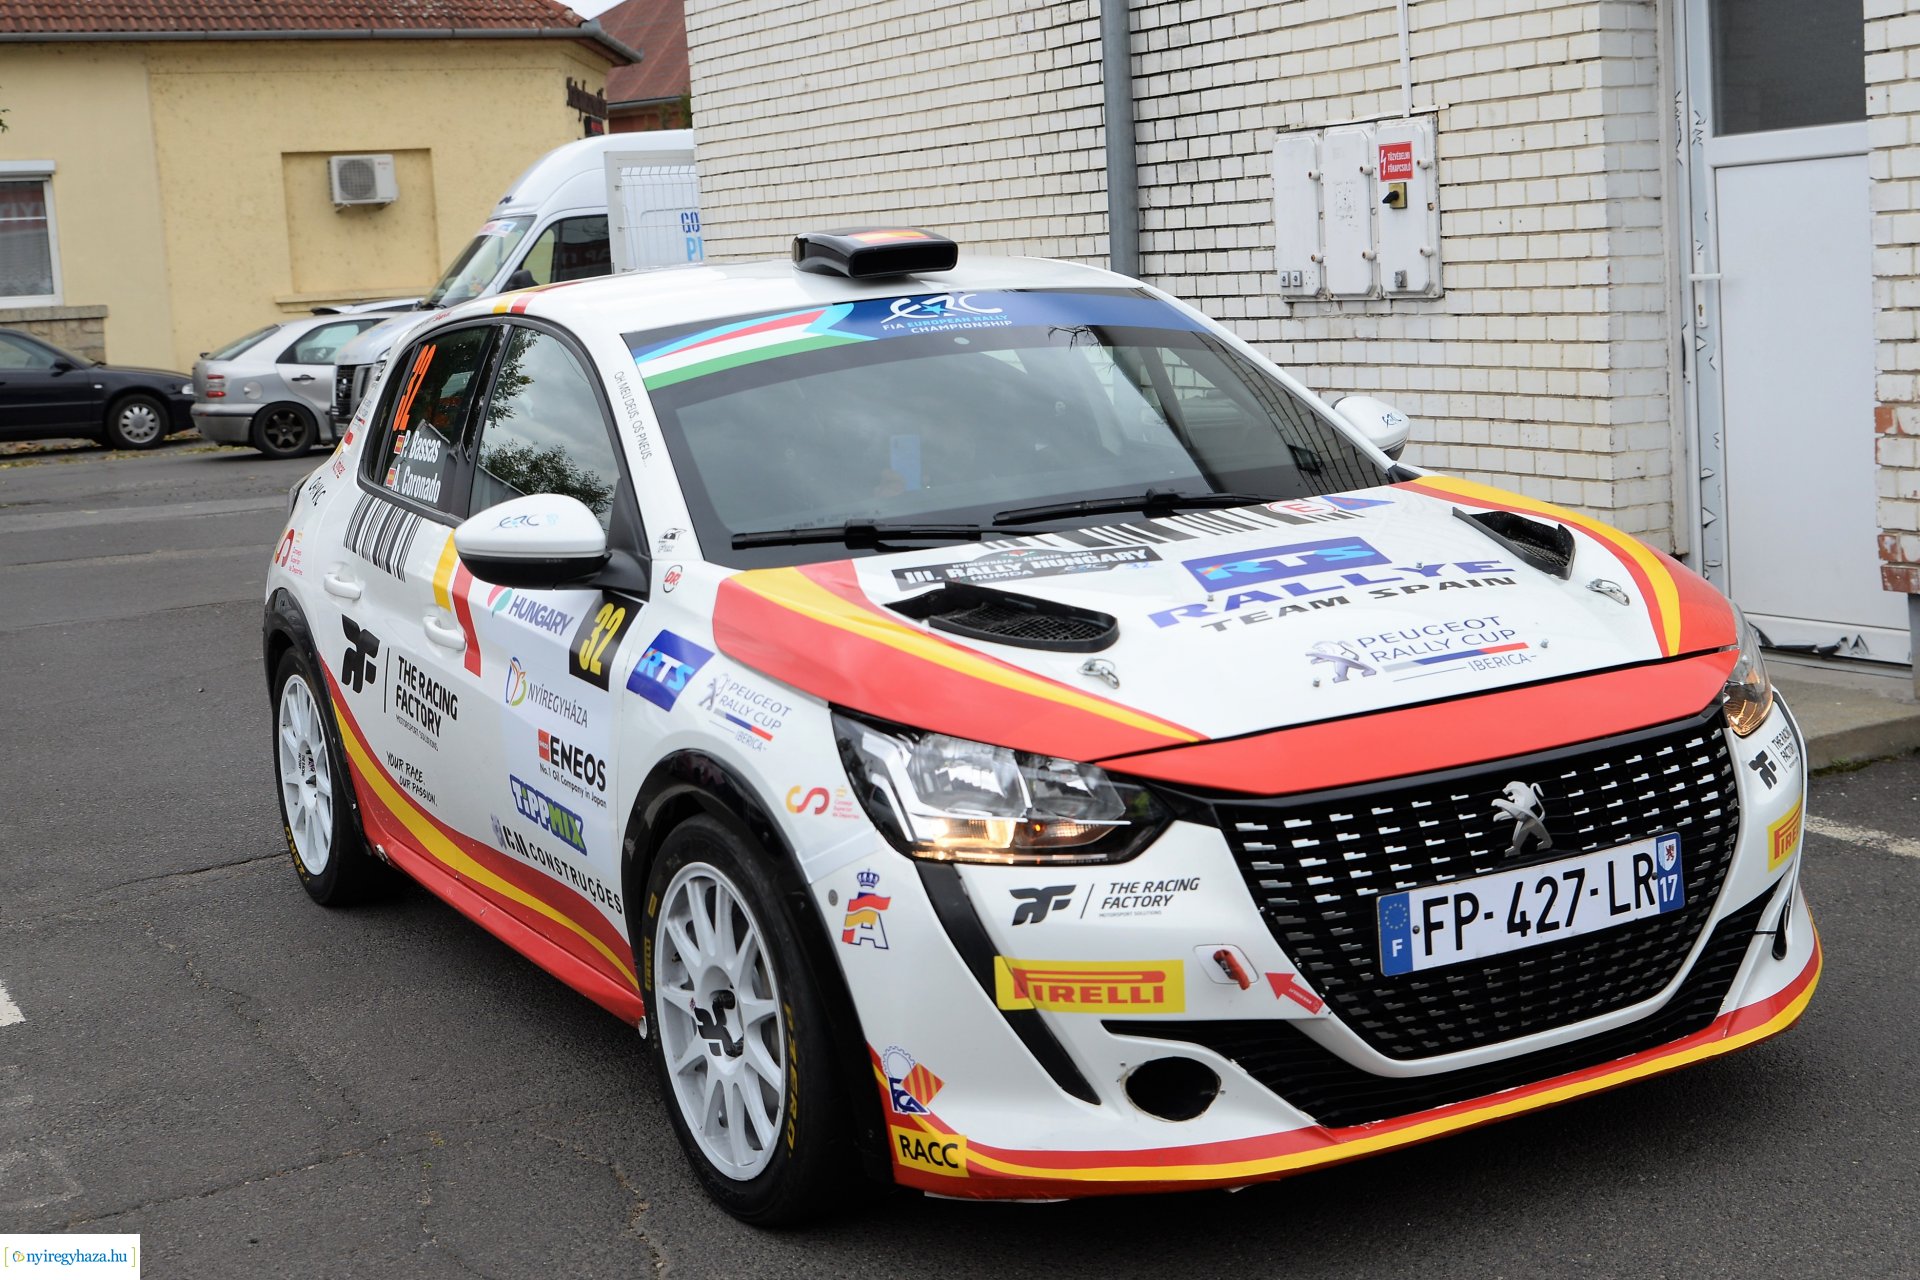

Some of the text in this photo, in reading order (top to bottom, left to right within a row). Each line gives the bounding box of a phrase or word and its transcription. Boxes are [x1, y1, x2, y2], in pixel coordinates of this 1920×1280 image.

[882, 314, 1009, 331] FIA EUROPEAN RALLY
[910, 320, 1013, 334] CHAMPIONSHIP
[393, 344, 437, 431] 32
[399, 429, 441, 464] P. Bassas
[401, 465, 441, 504] Coronado
[904, 549, 1147, 584] III. RALLY HUNGARY
[970, 570, 1034, 581] HUMDA
[1196, 544, 1377, 582] RTS
[1147, 559, 1517, 629] RALLYE
[1201, 575, 1518, 633] TEAM SPAIN
[508, 594, 574, 636] HUNGARY
[1357, 615, 1502, 649] PEUGEOT
[578, 602, 627, 676] 32
[1369, 628, 1516, 663] RALLY CUP
[636, 647, 695, 692] RTS
[1467, 653, 1532, 673] IBERICA
[398, 655, 458, 721] THE RACING
[527, 683, 588, 728] NYÍREGYHÁZA
[729, 681, 793, 718] PEUGEOT
[395, 684, 442, 738] FACTORY
[718, 694, 783, 731] RALLY CUP
[735, 730, 764, 753] IBERICA
[386, 750, 404, 773] YOUR
[550, 734, 606, 792] ENEOS
[399, 775, 411, 791] OUR
[552, 769, 560, 782] Oil
[560, 774, 585, 798] Company
[584, 787, 591, 799] in
[591, 791, 607, 809] Japan
[529, 842, 623, 915] CONSTRUÇÕES
[1110, 877, 1200, 895] THE RACING
[1659, 874, 1679, 904] 17
[1101, 894, 1174, 909] FACTORY
[1422, 852, 1657, 957] FP-427-LR
[1391, 938, 1403, 958] F
[1012, 967, 1167, 1005] PIRELLI
[898, 1134, 959, 1169] RACC
